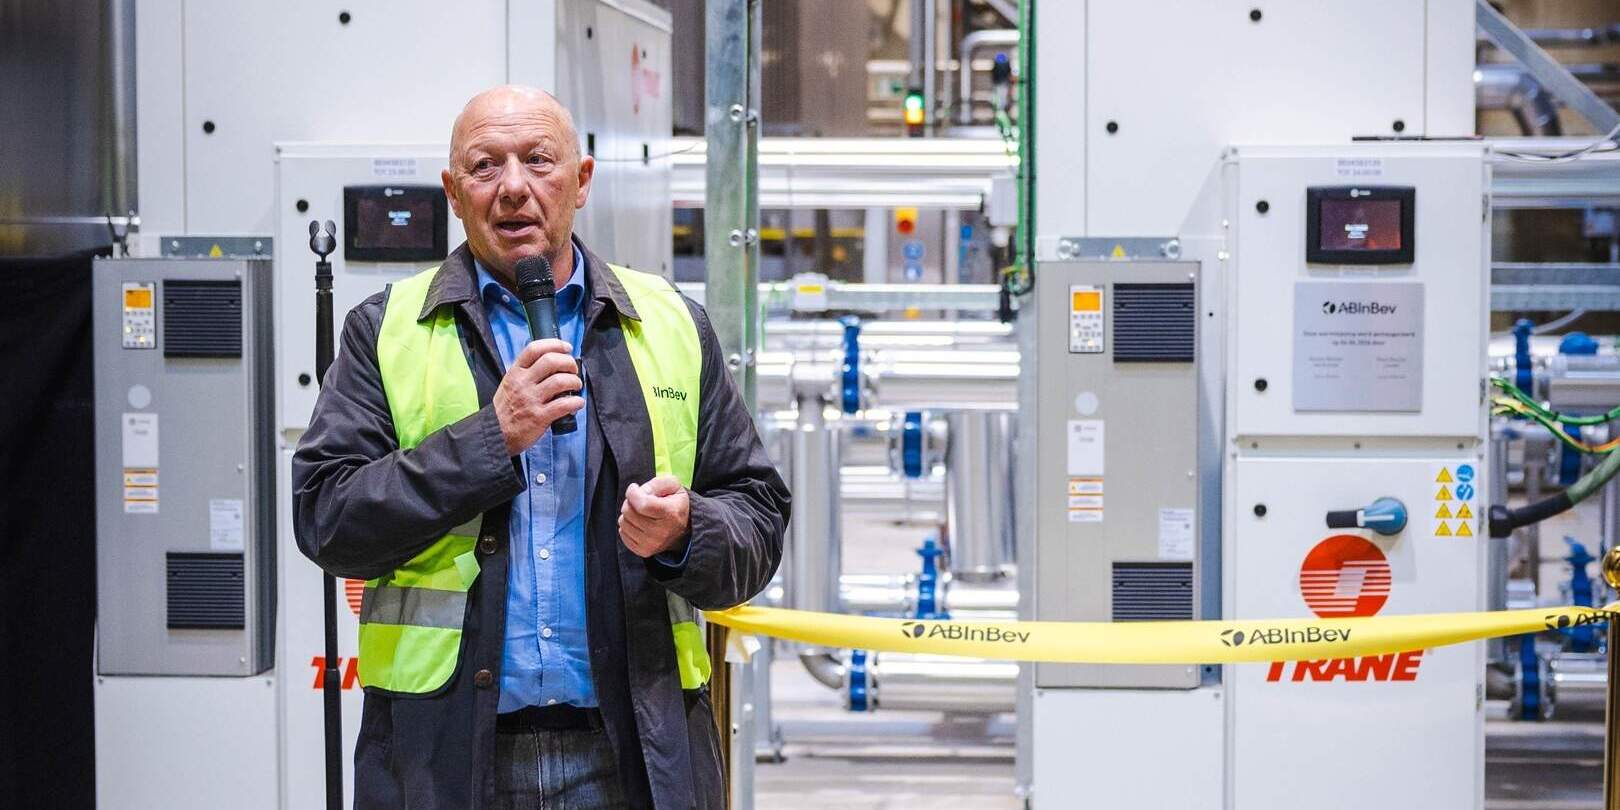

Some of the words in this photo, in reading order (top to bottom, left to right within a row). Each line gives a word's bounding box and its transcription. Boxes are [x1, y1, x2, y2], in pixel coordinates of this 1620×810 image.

[1338, 302, 1397, 314] ABInBev
[928, 624, 1031, 644] ABInBev
[1248, 626, 1351, 645] ABInBev
